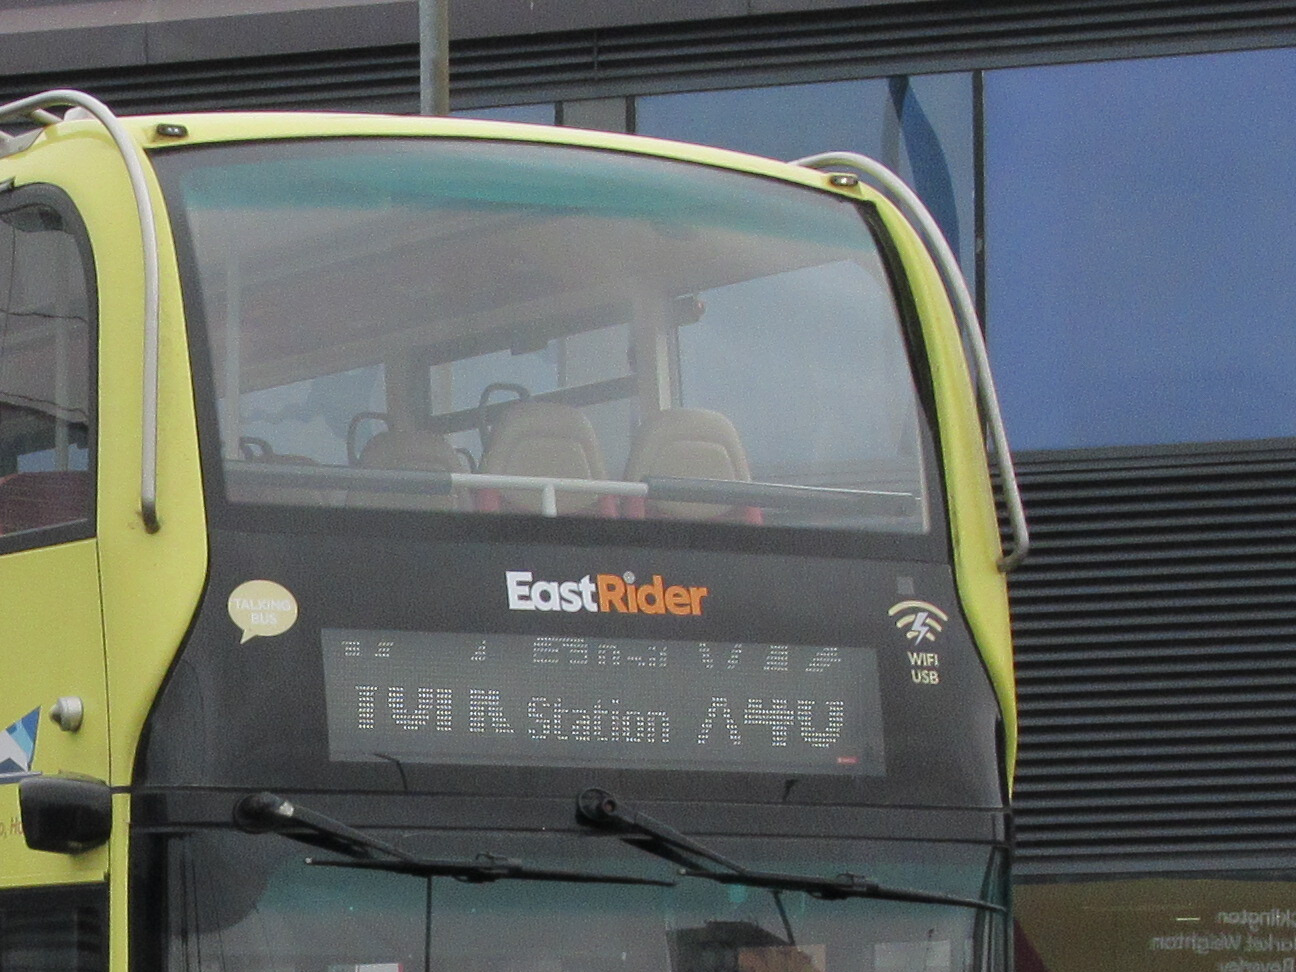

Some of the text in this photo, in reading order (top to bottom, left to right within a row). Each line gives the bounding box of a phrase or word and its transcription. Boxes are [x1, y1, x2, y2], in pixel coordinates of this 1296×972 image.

[506, 570, 708, 616] EastRider
[233, 598, 291, 611] TALKING
[250, 612, 277, 625] BUS
[907, 651, 939, 667] WIFI
[911, 669, 941, 685] USB
[527, 697, 670, 743] Station
